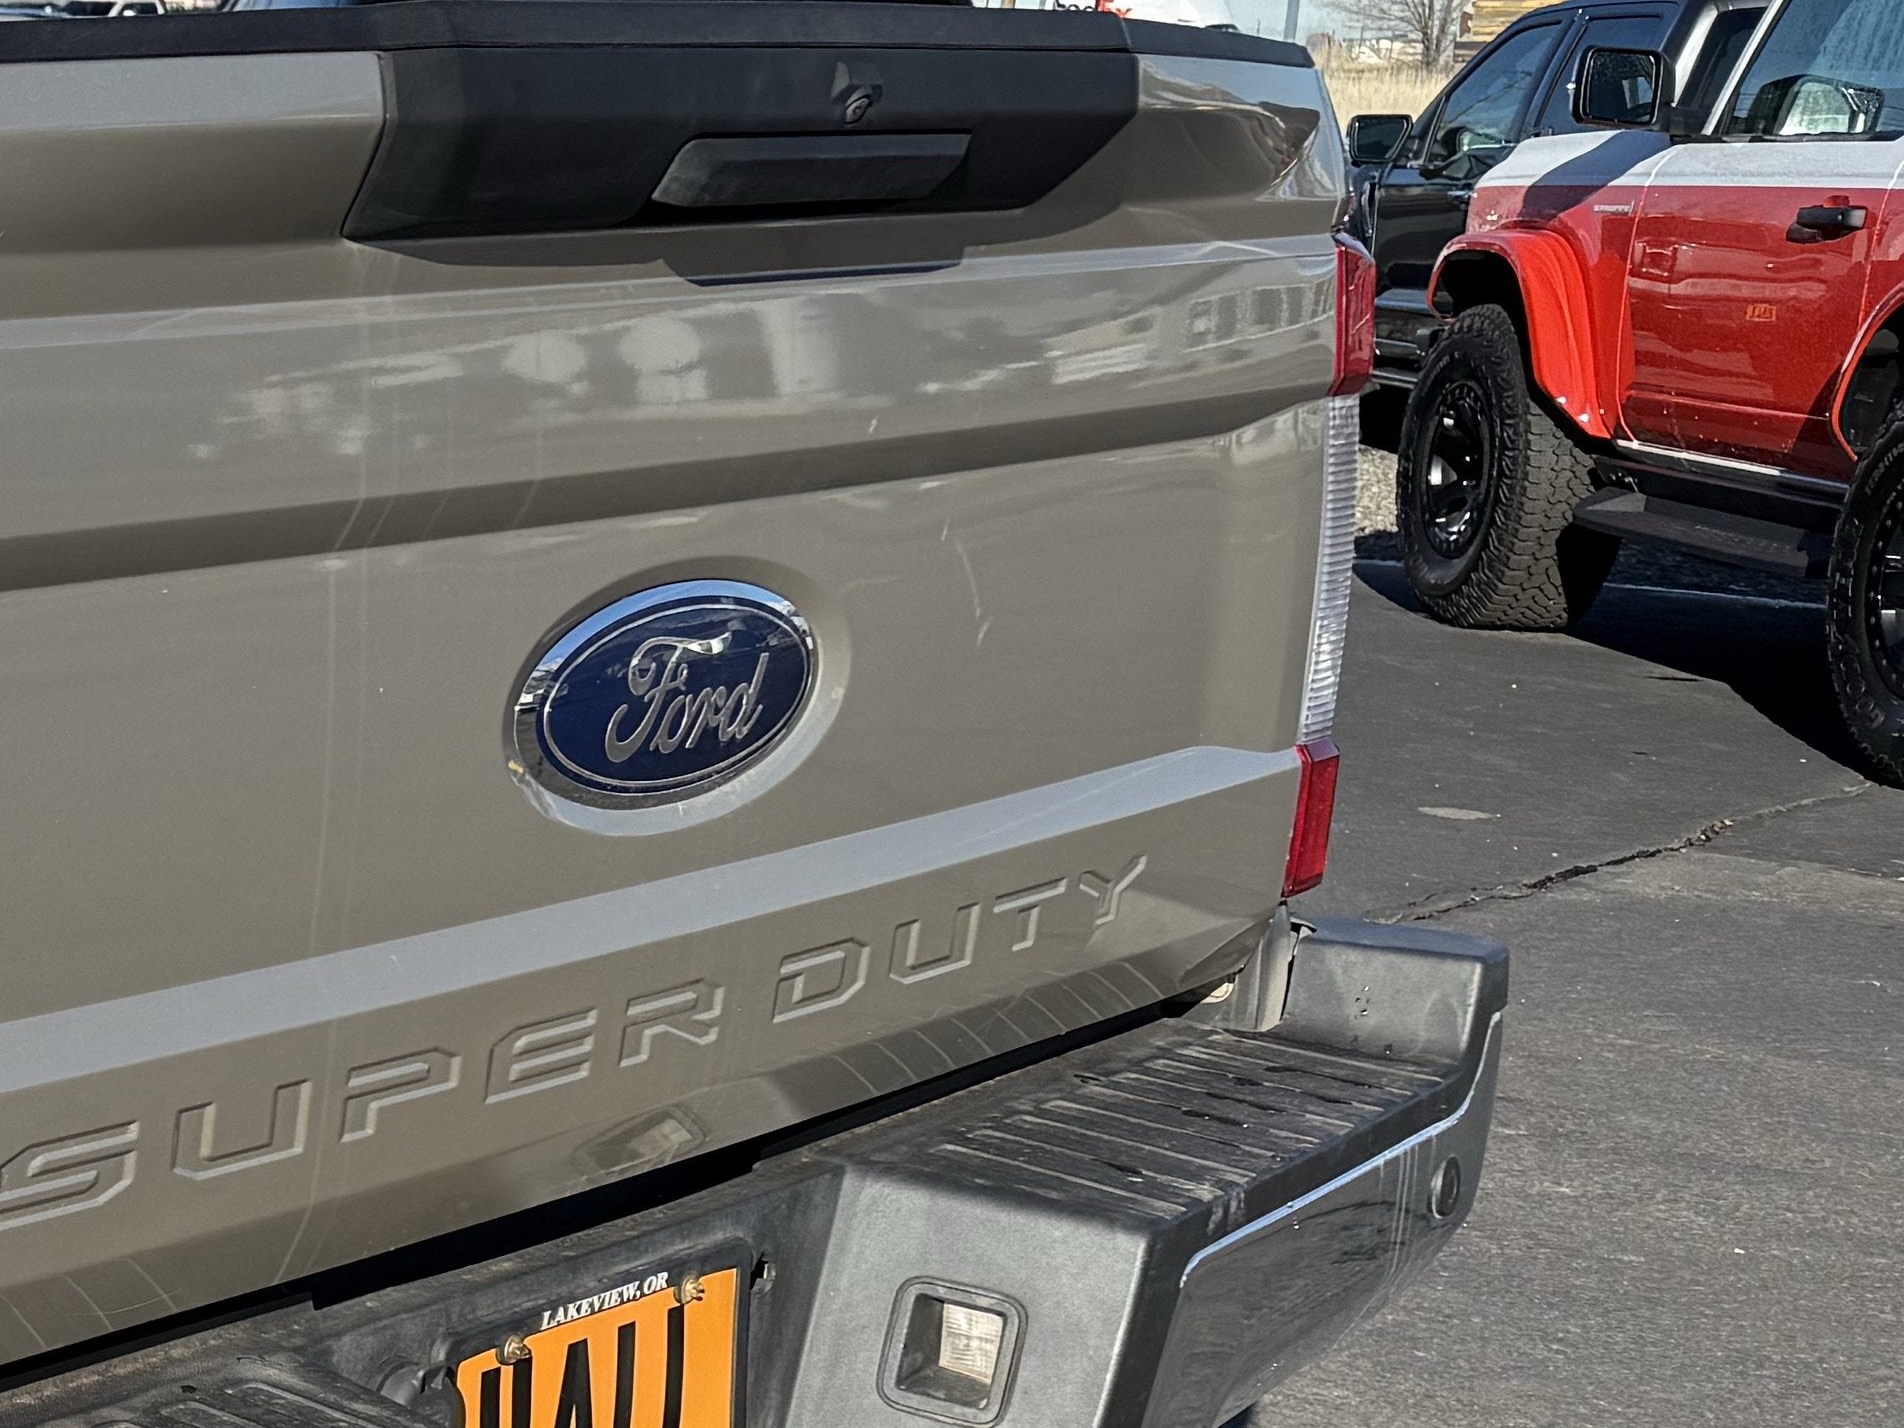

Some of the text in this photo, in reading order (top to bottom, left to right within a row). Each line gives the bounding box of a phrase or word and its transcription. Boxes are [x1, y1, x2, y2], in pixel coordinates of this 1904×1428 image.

[604, 632, 770, 764] Ford
[771, 852, 1149, 1026] DUTY
[539, 1271, 669, 1331] LAKEVIEW, OR
